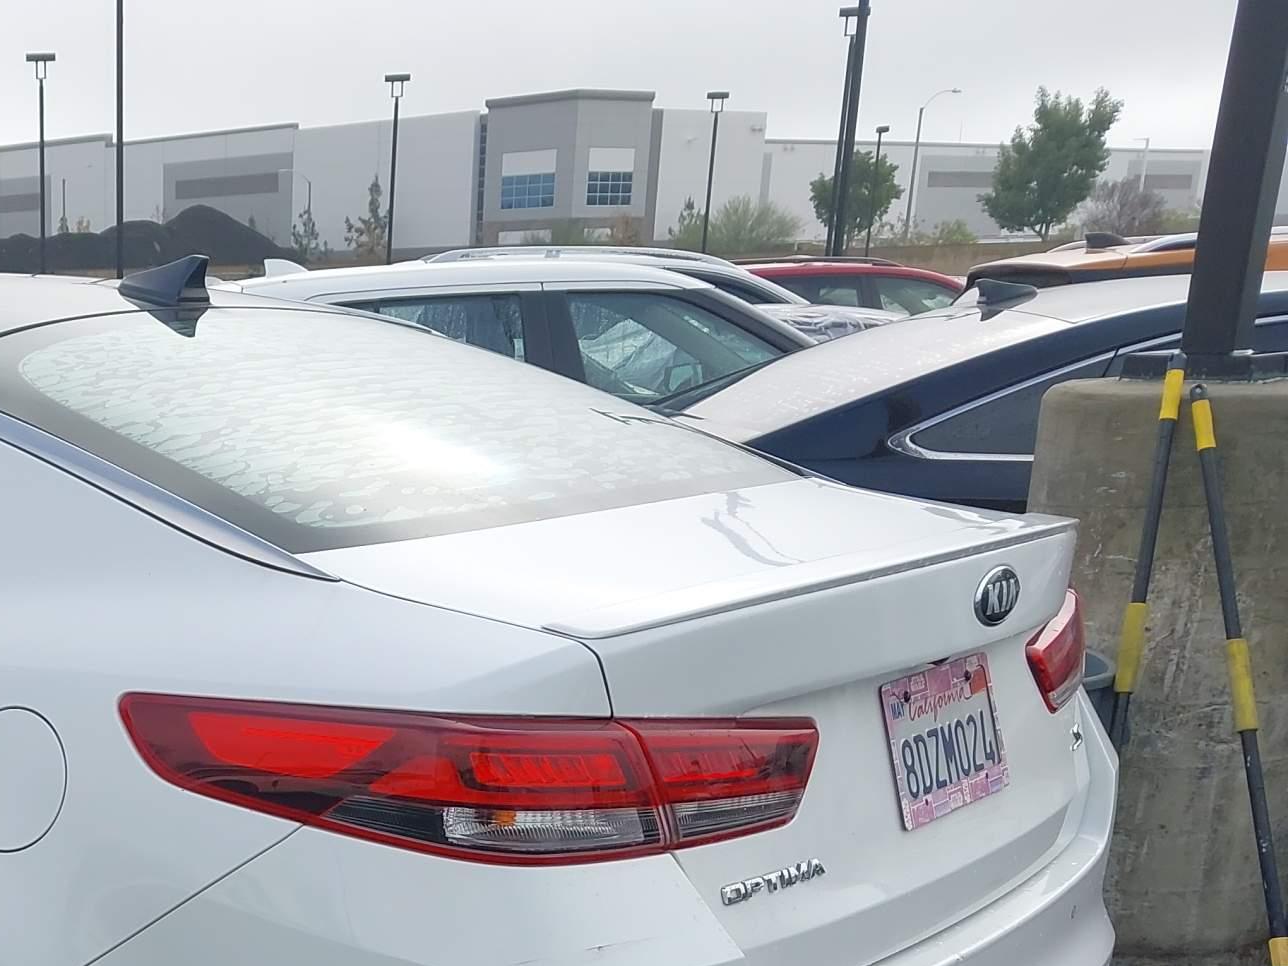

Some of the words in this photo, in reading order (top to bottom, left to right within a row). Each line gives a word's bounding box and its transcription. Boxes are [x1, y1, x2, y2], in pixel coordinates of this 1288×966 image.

[908, 686, 973, 722] California
[901, 709, 997, 799] 8DZM024
[721, 858, 827, 906] OPTIMA
